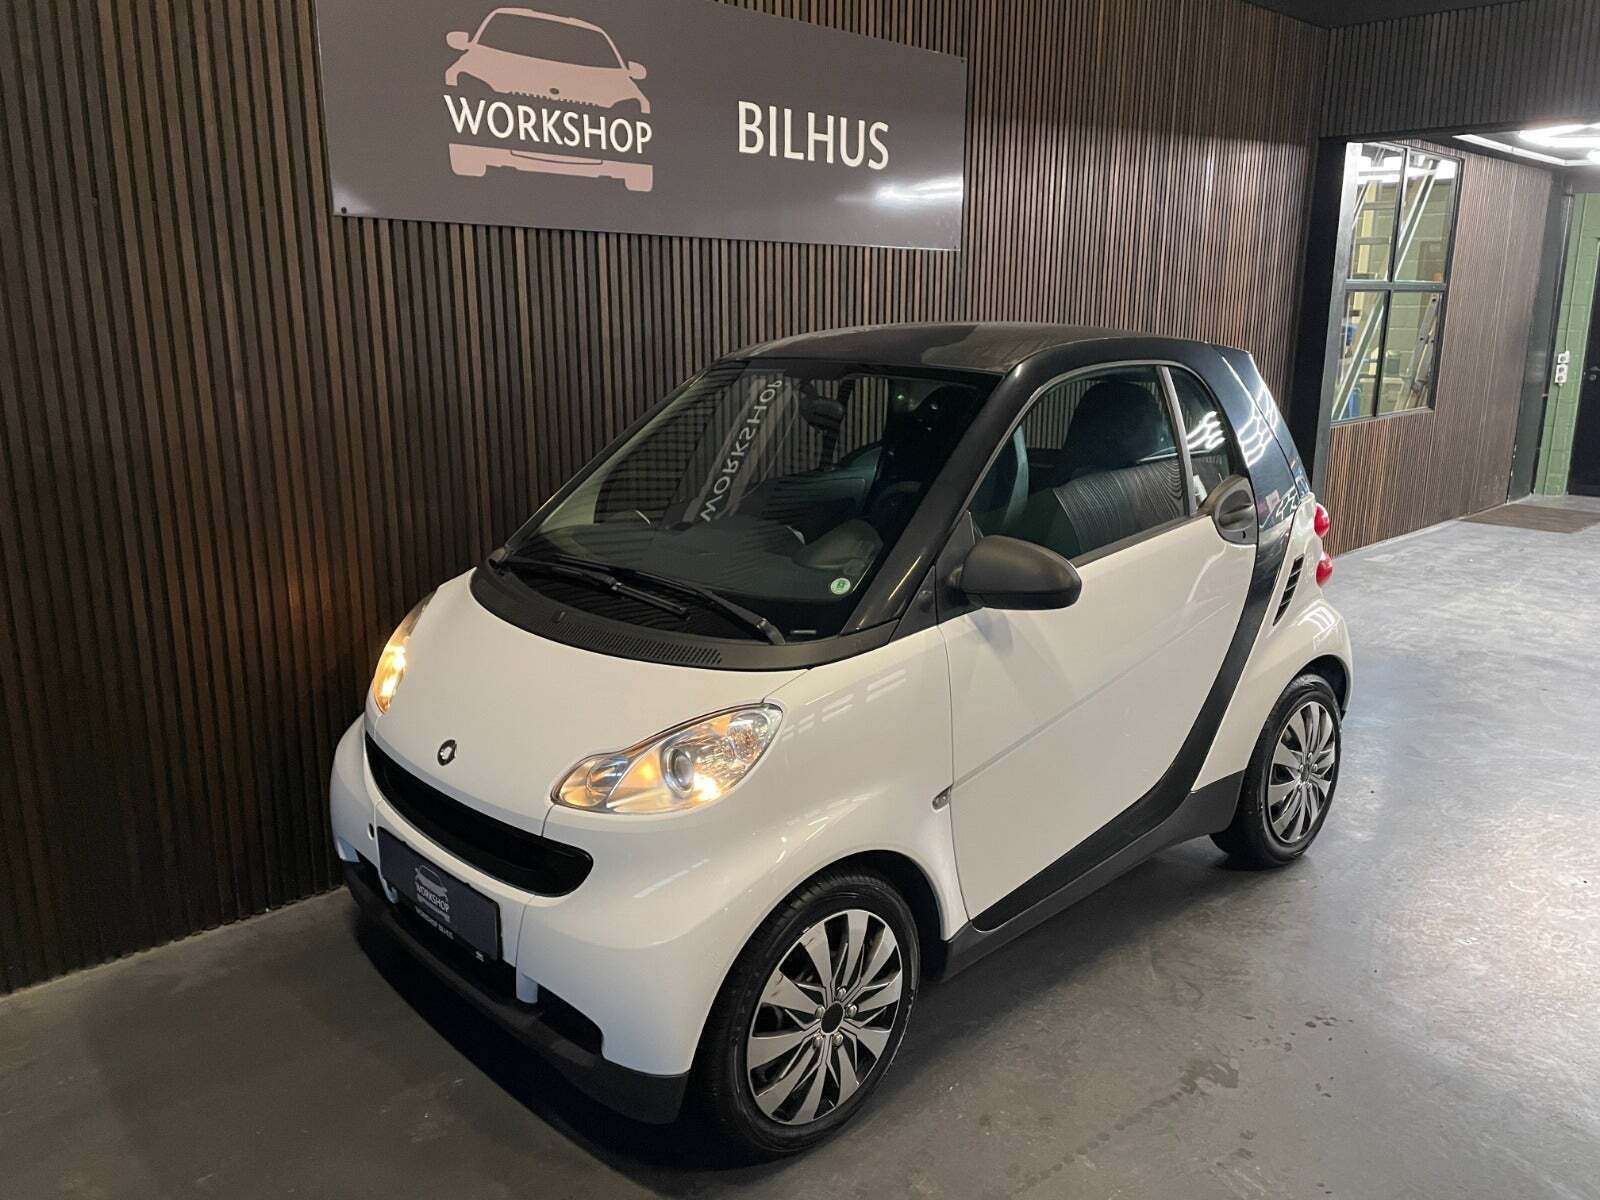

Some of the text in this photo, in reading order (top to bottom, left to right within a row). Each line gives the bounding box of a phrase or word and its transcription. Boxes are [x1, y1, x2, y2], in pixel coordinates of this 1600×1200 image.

[443, 94, 653, 154] WORKSHOP
[738, 100, 890, 171] BILHUS
[414, 880, 451, 913] WORKSHOP
